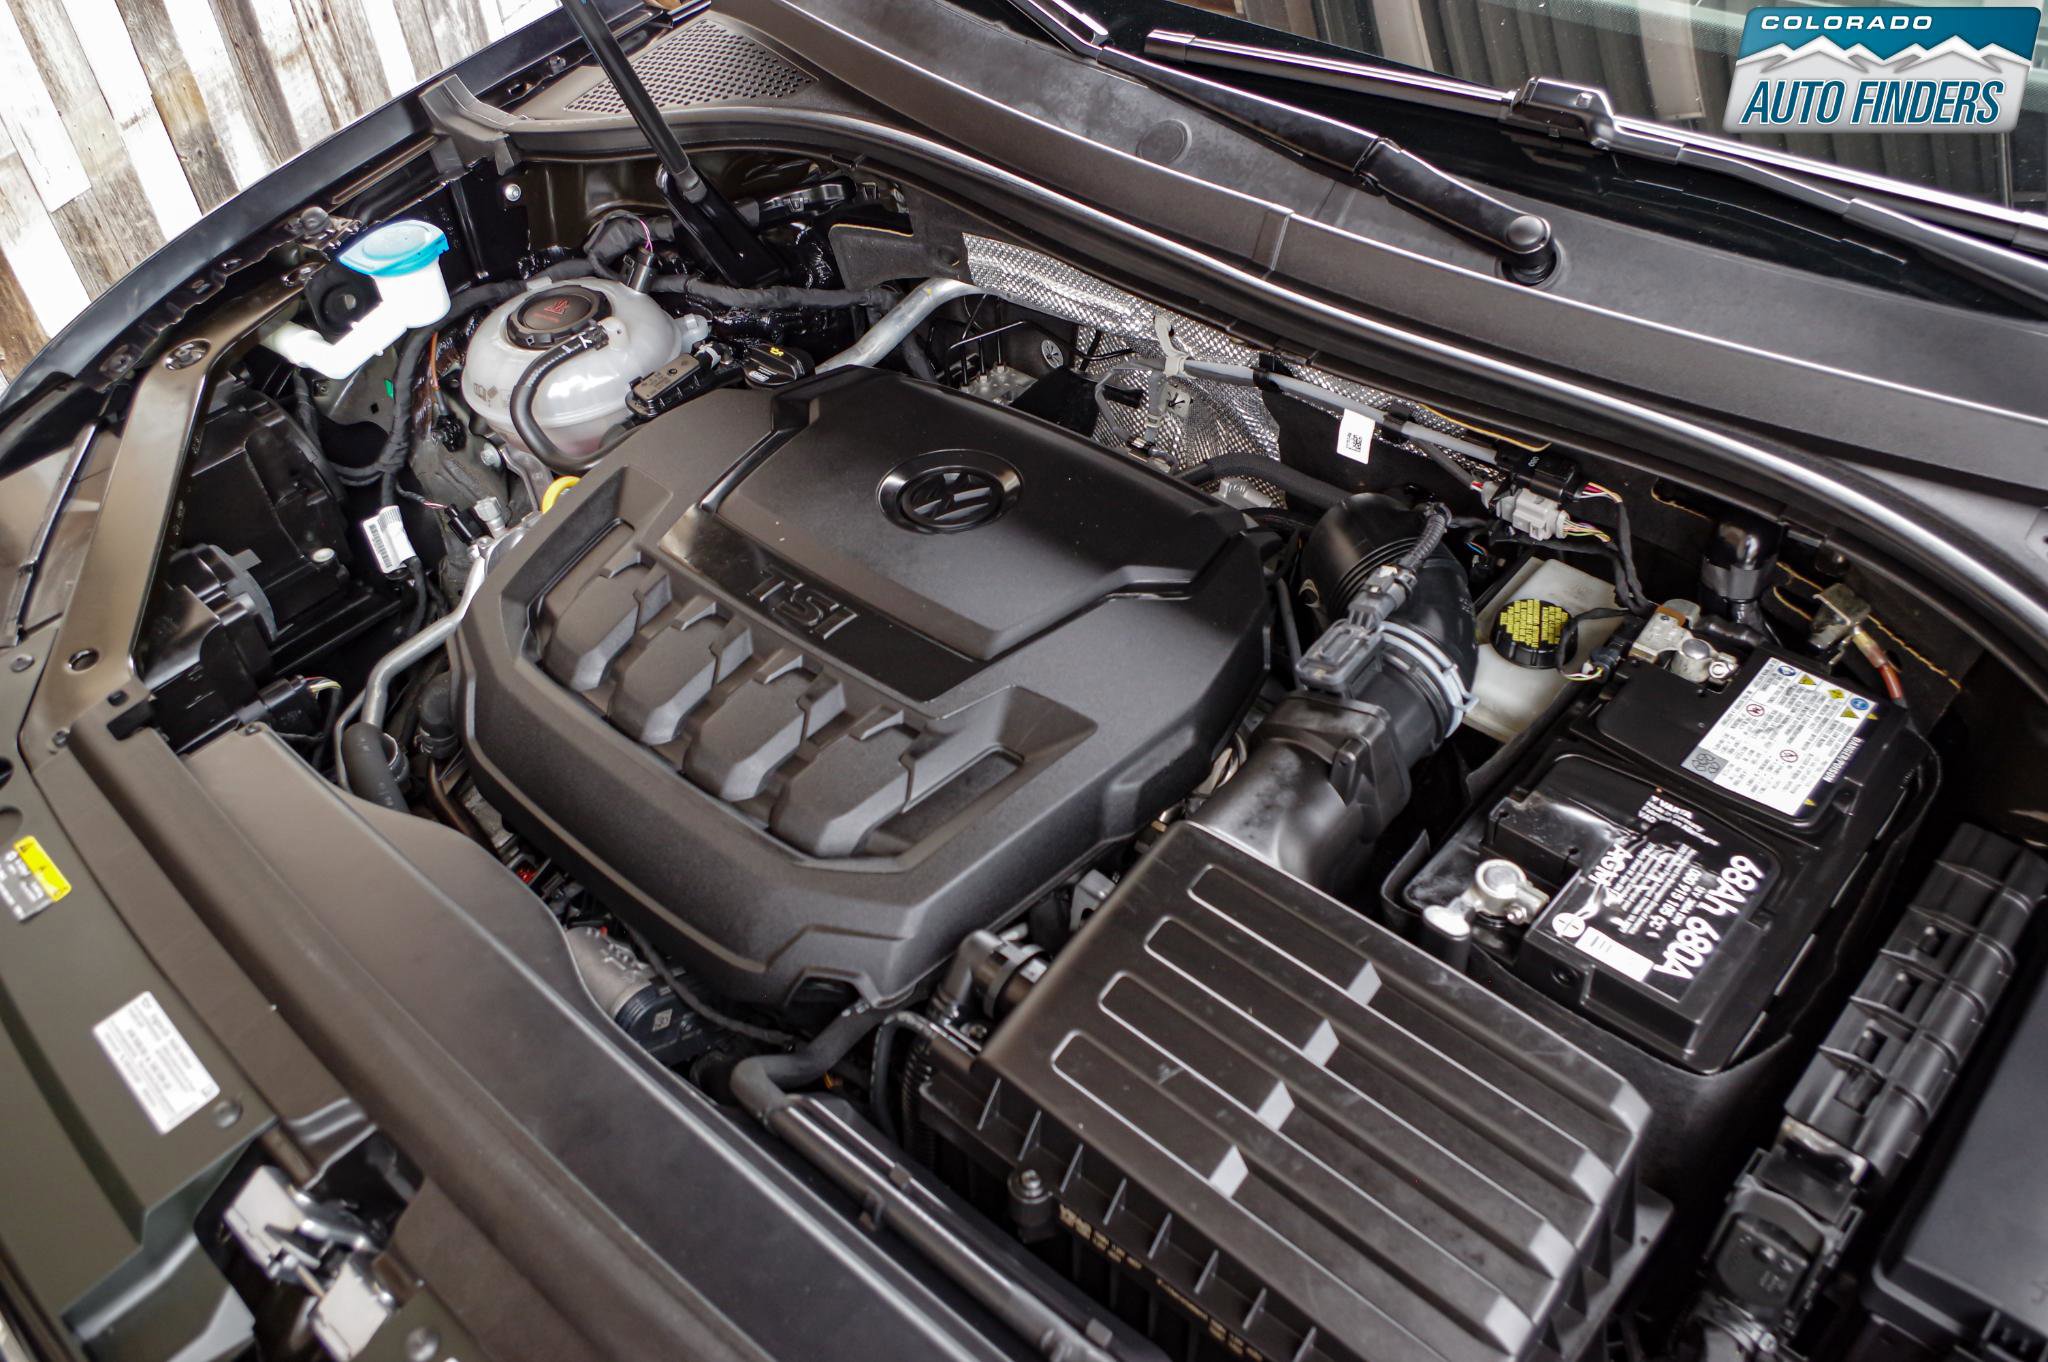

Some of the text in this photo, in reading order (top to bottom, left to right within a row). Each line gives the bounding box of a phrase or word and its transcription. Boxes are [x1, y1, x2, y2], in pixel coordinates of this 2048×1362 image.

[748, 566, 858, 640] TSI
[1822, 736, 1865, 784] DANGER/POISON
[1588, 843, 1634, 887] AGM
[1699, 855, 1765, 915] 68Ah
[1658, 901, 1681, 917] 105
[1670, 884, 1691, 901] 915
[1653, 916, 1722, 980] 680A
